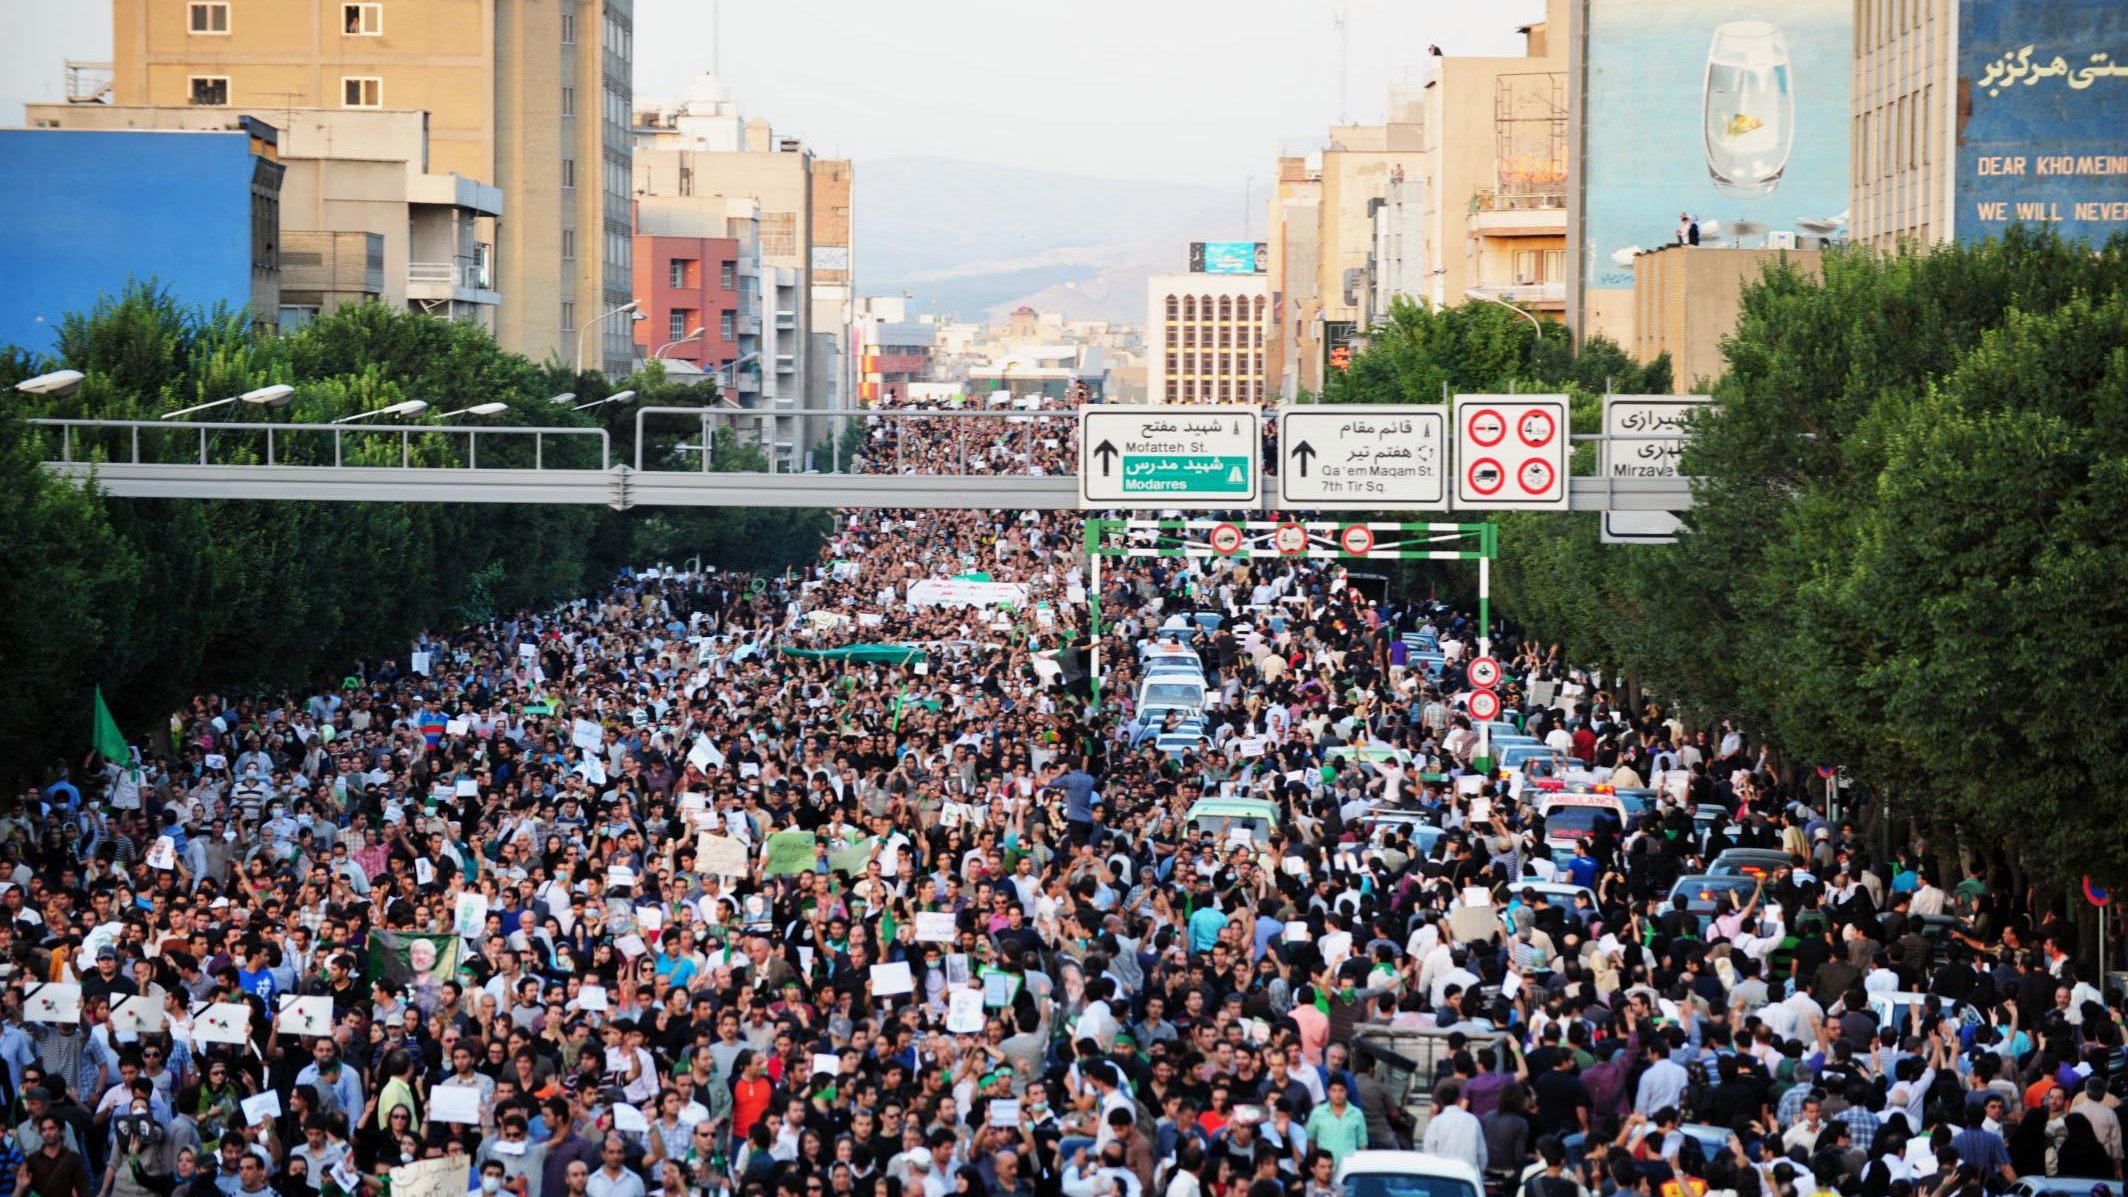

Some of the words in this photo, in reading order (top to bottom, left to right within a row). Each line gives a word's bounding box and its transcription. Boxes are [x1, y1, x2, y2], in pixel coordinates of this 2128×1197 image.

[1977, 156, 2026, 176] DEAR
[2036, 155, 2128, 176] KHOMEINI
[1977, 202, 2008, 221] WE
[2016, 202, 2064, 221] WILL
[1141, 420, 1178, 438] مفتح
[1183, 419, 1223, 436] شهید
[1340, 421, 1375, 439] مقام
[1379, 420, 1412, 441] قائم
[1125, 442, 1185, 453] Mofatteh
[1191, 442, 1208, 453] St.
[1346, 446, 1370, 461] تیر
[1375, 446, 1412, 464] هفتم
[1126, 458, 1179, 475] مدرس
[1183, 457, 1224, 474] شهید
[1370, 465, 1416, 478] Maqam
[1418, 465, 1434, 477] St.
[1125, 479, 1188, 491] Modarres
[1321, 480, 1342, 492] 7th
[1347, 480, 1363, 492] Tir
[1366, 481, 1386, 494] Sq.
[1547, 795, 1618, 805] AMBULANCE
